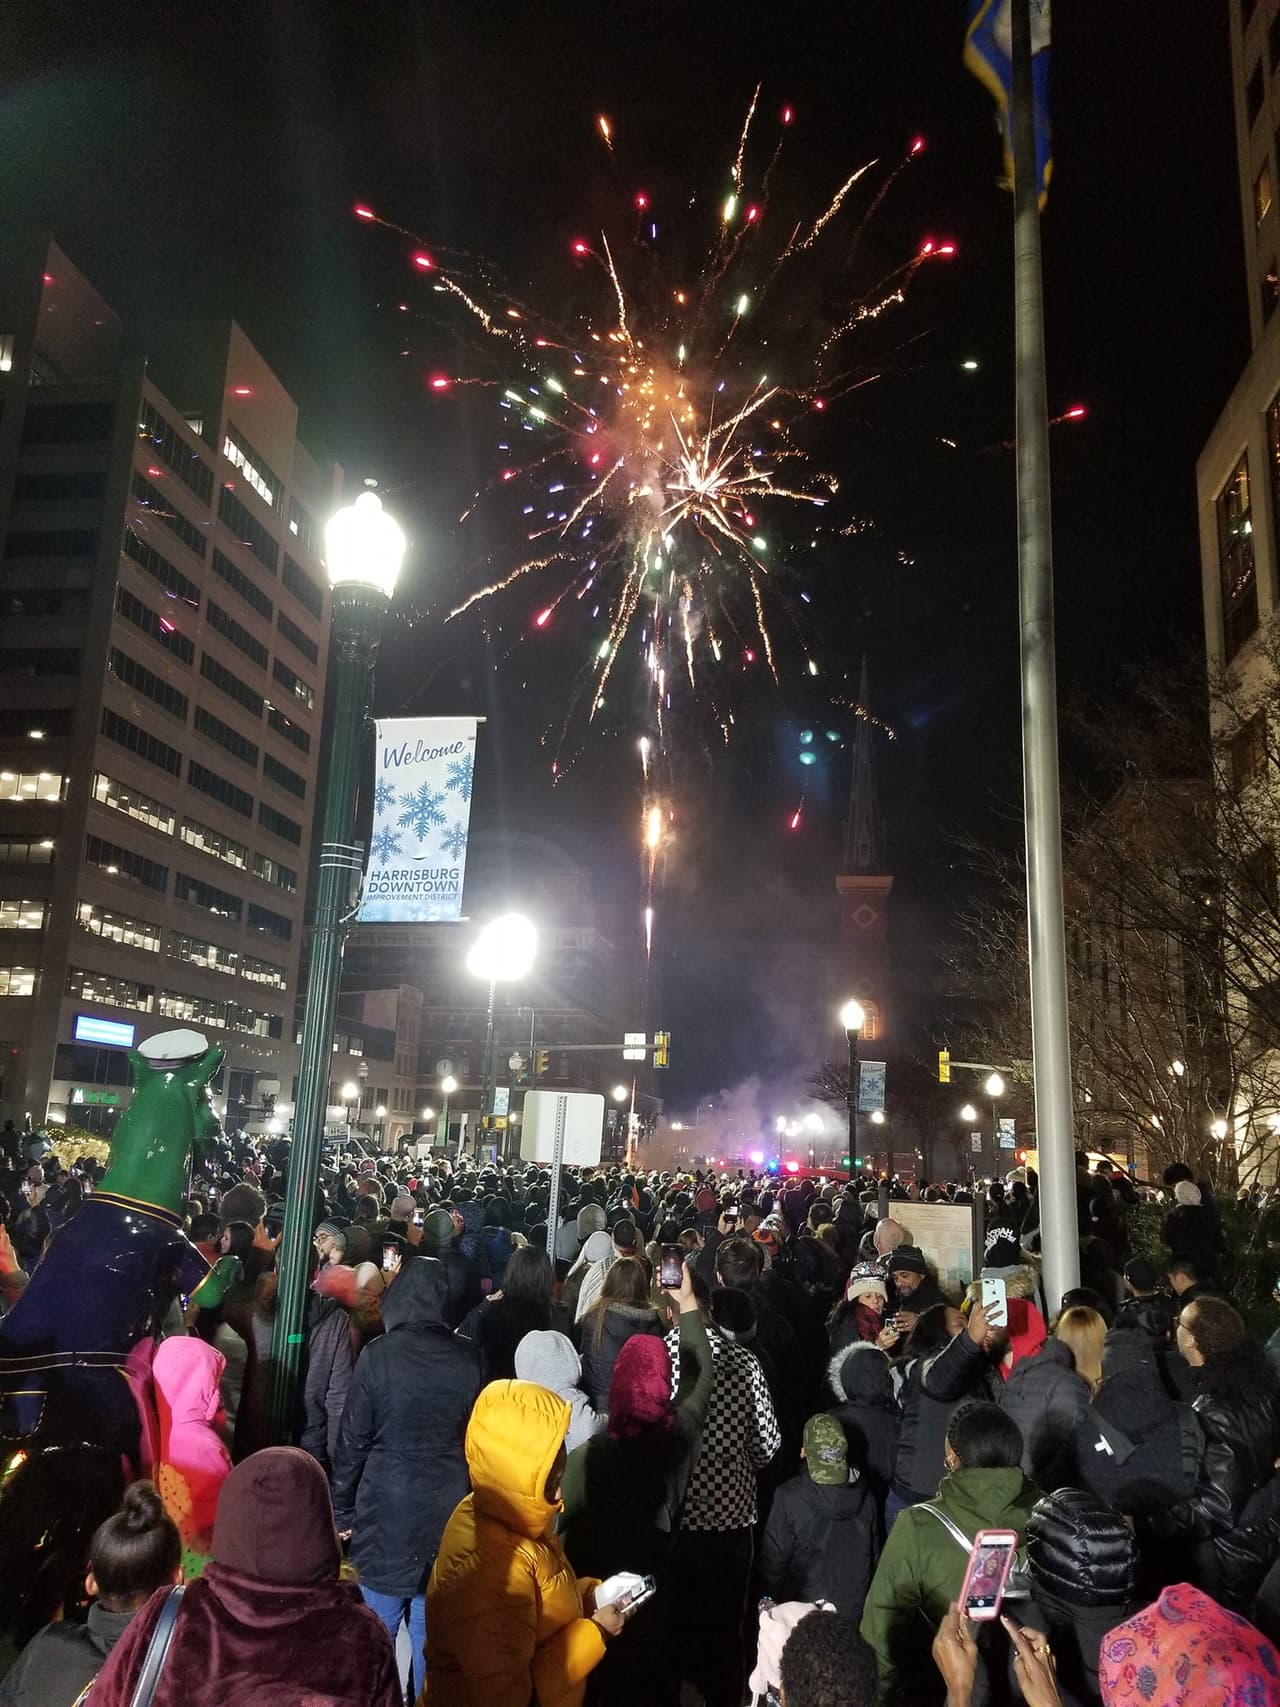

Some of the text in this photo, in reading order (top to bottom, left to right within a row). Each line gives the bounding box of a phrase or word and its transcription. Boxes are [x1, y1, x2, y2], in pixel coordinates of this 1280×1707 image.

[384, 739, 466, 769] Welcome
[371, 868, 460, 881] HARRISBURG
[368, 881, 459, 893] DOWNTOWN
[424, 893, 458, 901] DISTRICT
